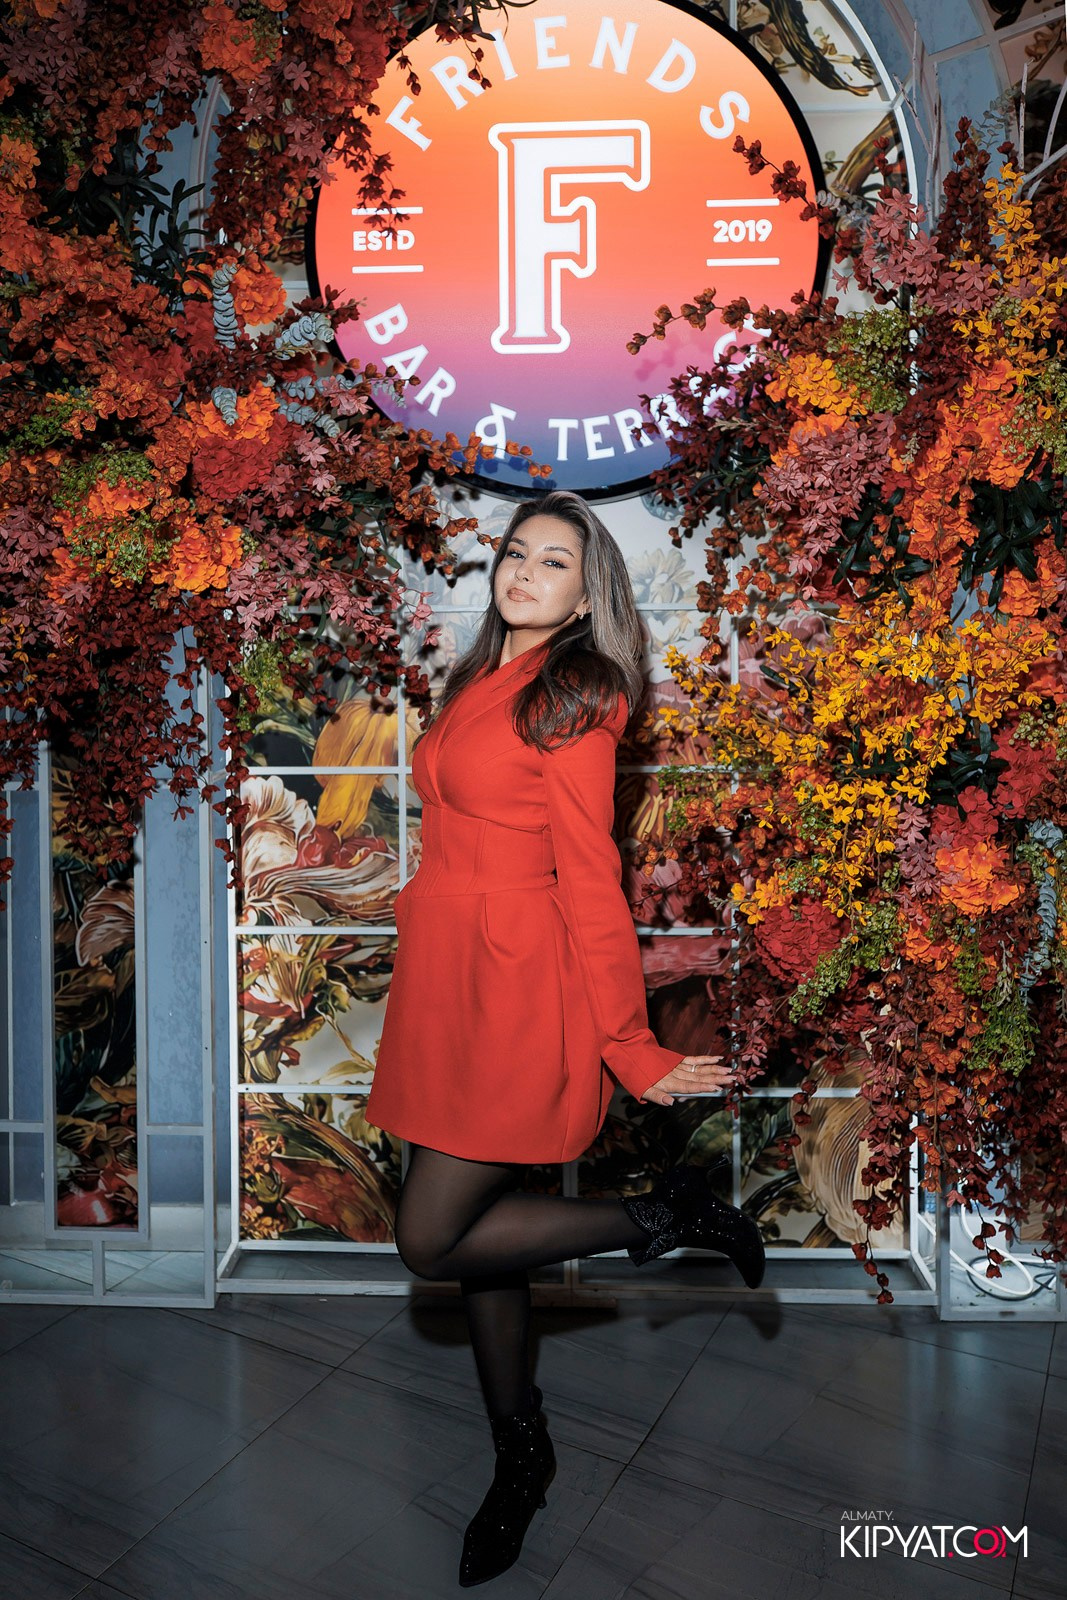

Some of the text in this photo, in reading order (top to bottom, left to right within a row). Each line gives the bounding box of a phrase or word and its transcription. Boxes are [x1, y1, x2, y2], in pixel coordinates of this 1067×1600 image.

[385, 15, 751, 151] FRIENDS
[488, 119, 651, 355] F
[713, 218, 773, 243] 2019
[364, 303, 457, 417] BAR
